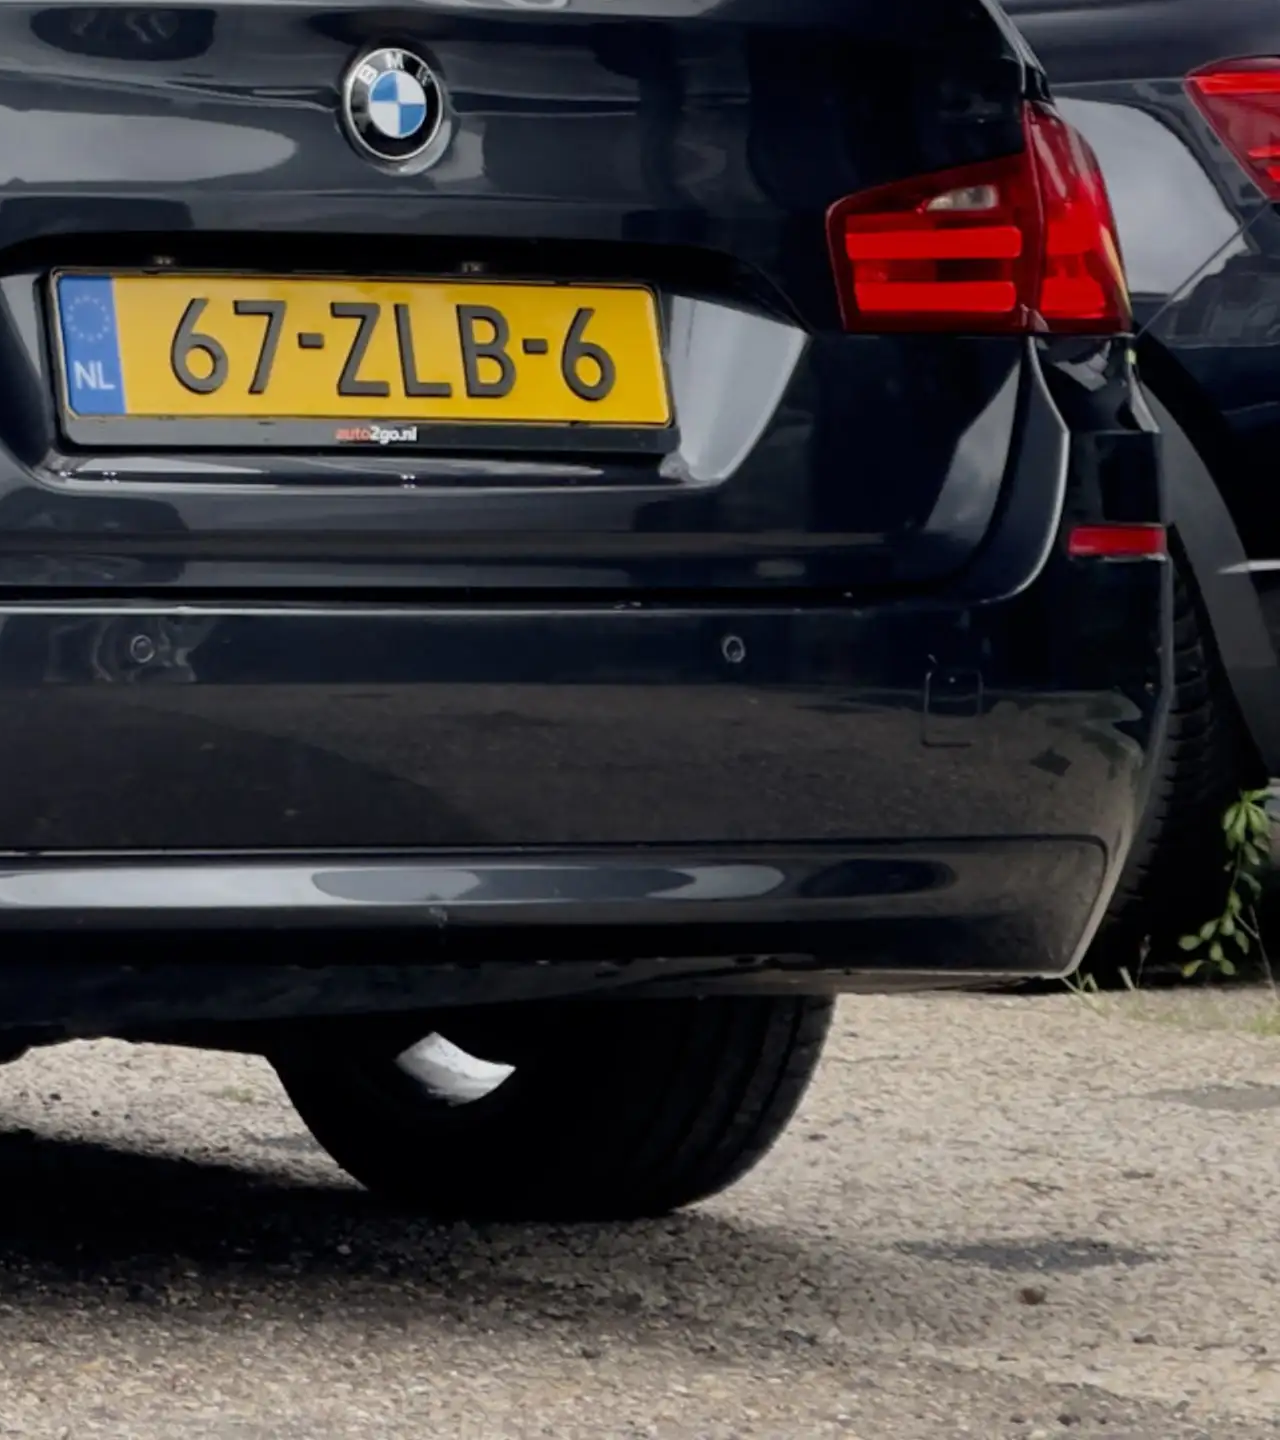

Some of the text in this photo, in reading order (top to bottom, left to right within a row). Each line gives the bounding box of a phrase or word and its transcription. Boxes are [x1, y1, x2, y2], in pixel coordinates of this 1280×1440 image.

[169, 297, 616, 402] 67-ZLB-6
[73, 360, 116, 390] NL
[335, 425, 417, 446] auto2go.nl
